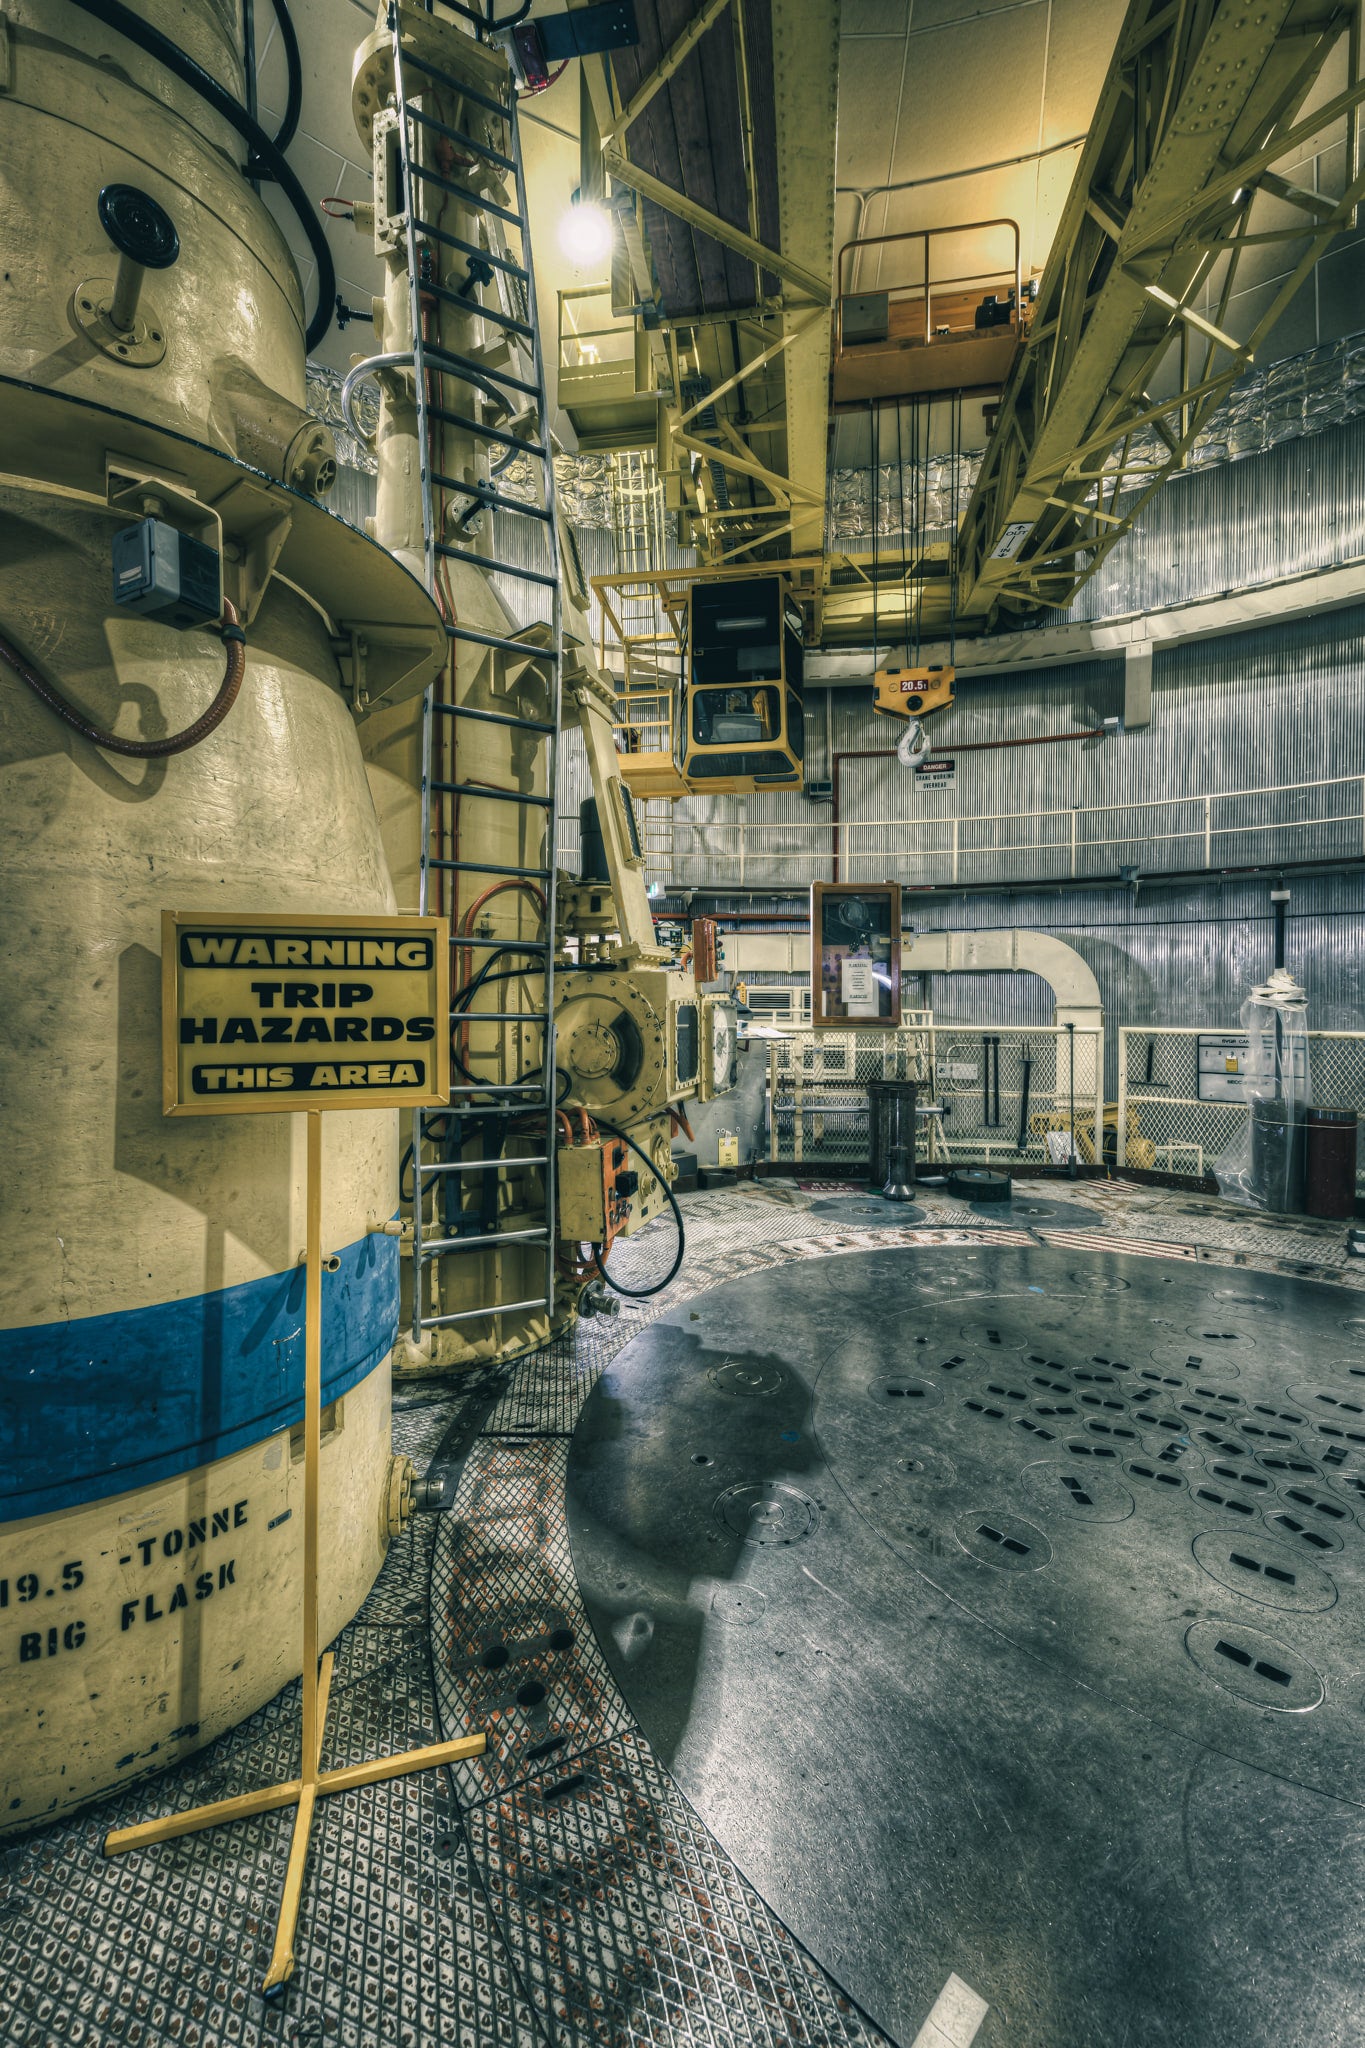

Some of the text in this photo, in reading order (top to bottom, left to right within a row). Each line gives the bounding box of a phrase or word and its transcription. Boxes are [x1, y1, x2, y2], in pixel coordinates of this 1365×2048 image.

[923, 763, 947, 771] DANGER
[923, 781, 947, 789] OVERHEAD
[187, 937, 427, 967] WARNING
[251, 982, 374, 1009] TRIP
[180, 1017, 435, 1044] HAZARDS
[201, 1063, 420, 1090] THIS AREA
[0, 1560, 85, 1608] 19.5
[19, 1558, 237, 1663] BIG FLASK
